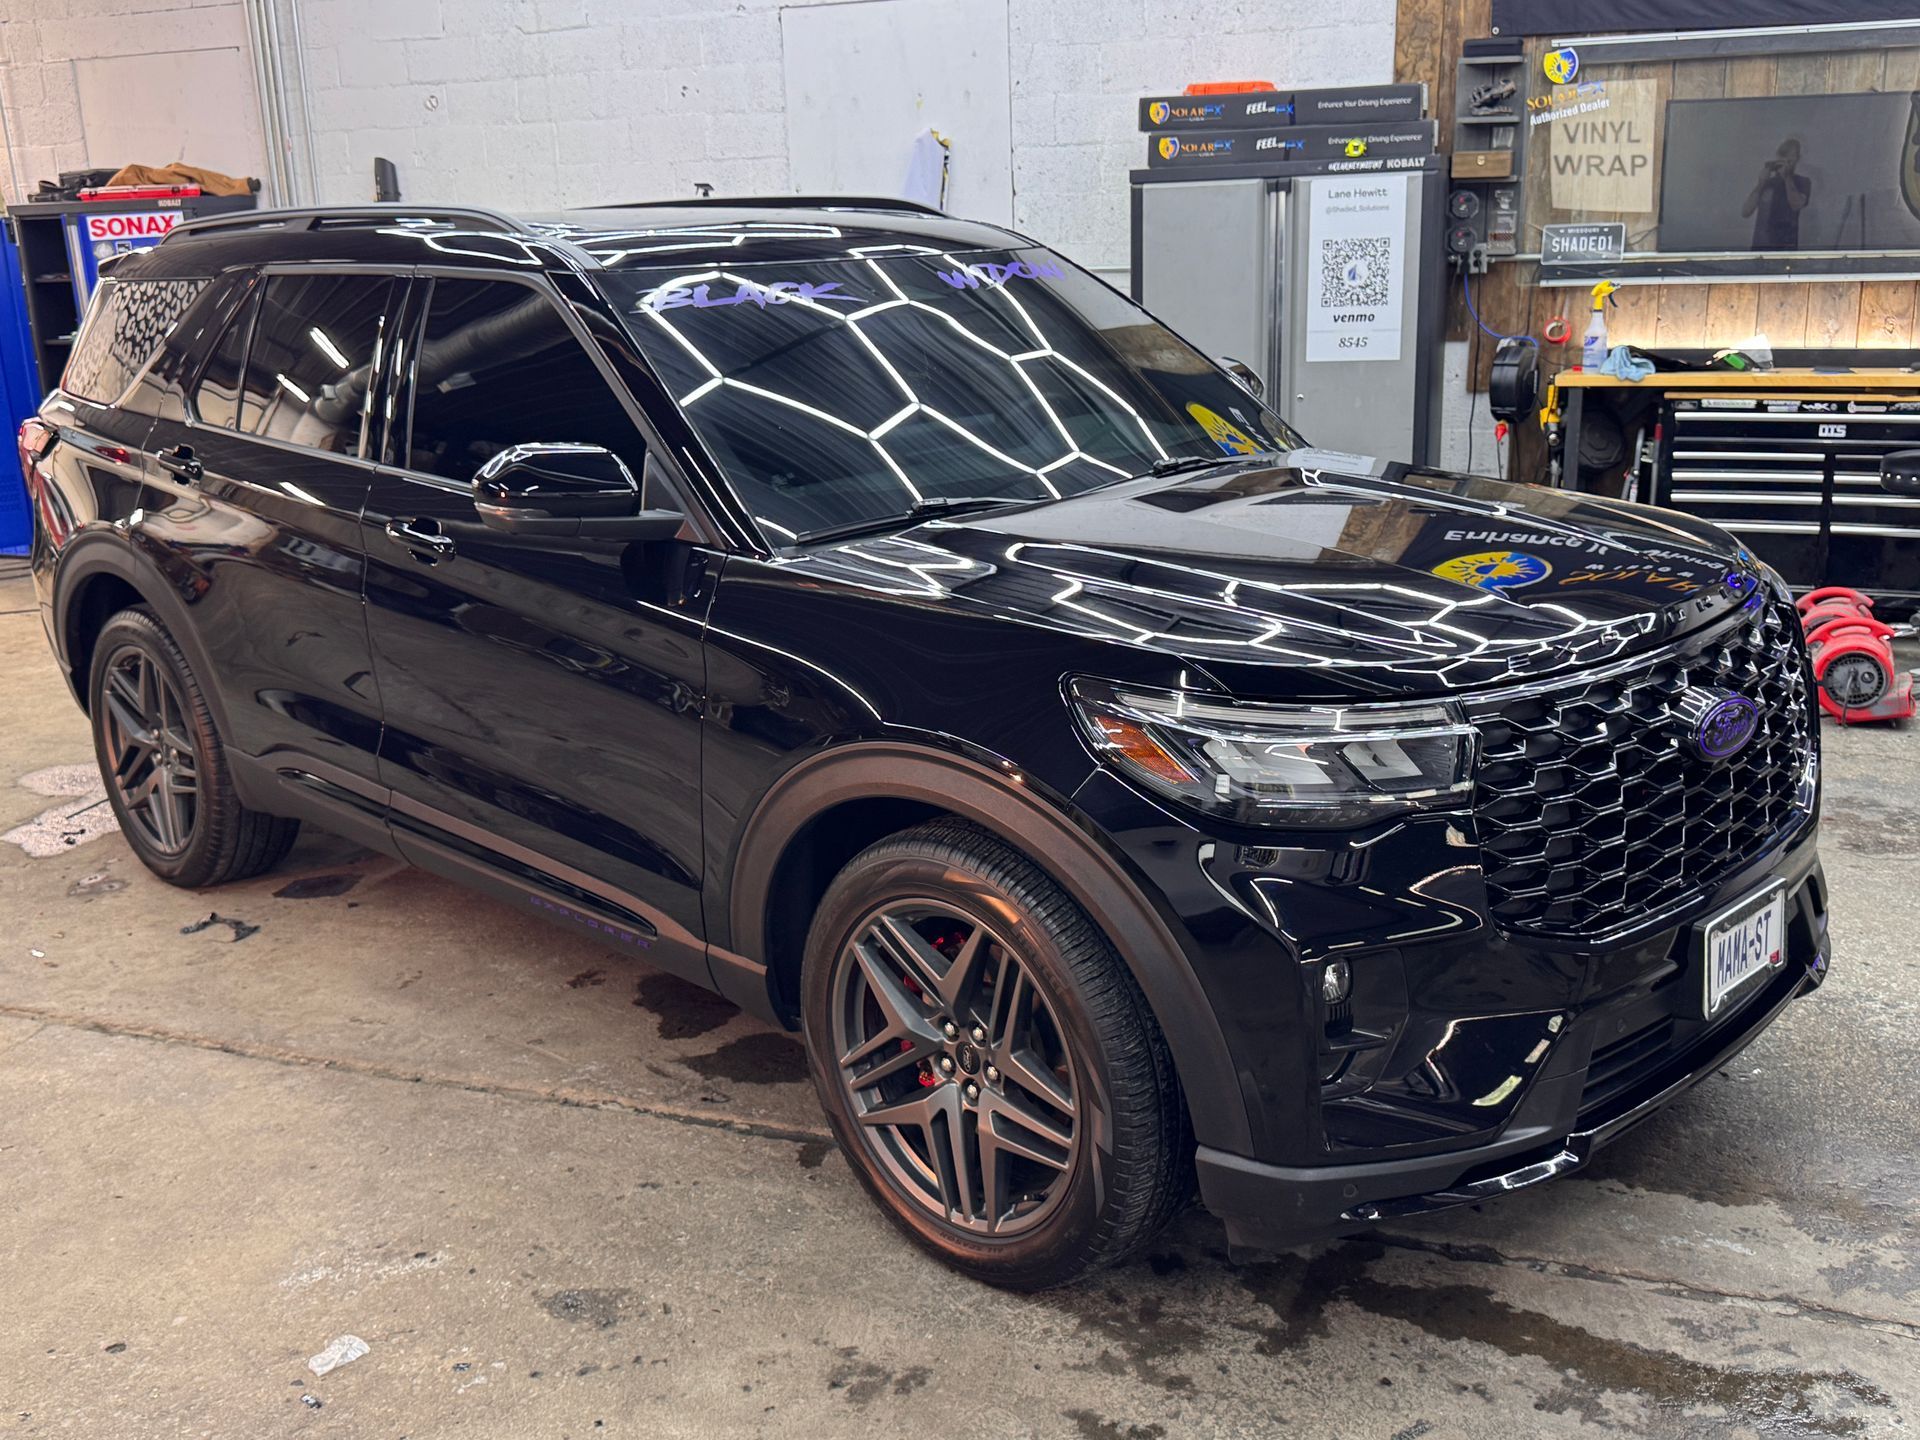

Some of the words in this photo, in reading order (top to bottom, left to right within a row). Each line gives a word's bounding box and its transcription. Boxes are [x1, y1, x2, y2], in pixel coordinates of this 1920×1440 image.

[1246, 101, 1268, 115] FEEL
[1530, 105, 1578, 126] Authorized
[1580, 98, 1610, 113] Dealer
[1563, 120, 1641, 144] VINYL
[1256, 136, 1278, 151] FEEL
[1328, 136, 1352, 145] Enhan
[1386, 157, 1426, 169] KOBALT
[1553, 154, 1648, 177] WRAP
[1328, 189, 1351, 199] Lane
[1354, 187, 1388, 198] Hewitt
[158, 199, 182, 207] KOBALT
[90, 214, 175, 238] SONAX
[632, 279, 866, 314] BLACK
[936, 258, 1066, 290] WIDOW
[1332, 313, 1375, 323] venmo
[1338, 337, 1368, 348] 8545
[1716, 909, 1772, 989] MAMA-ST
